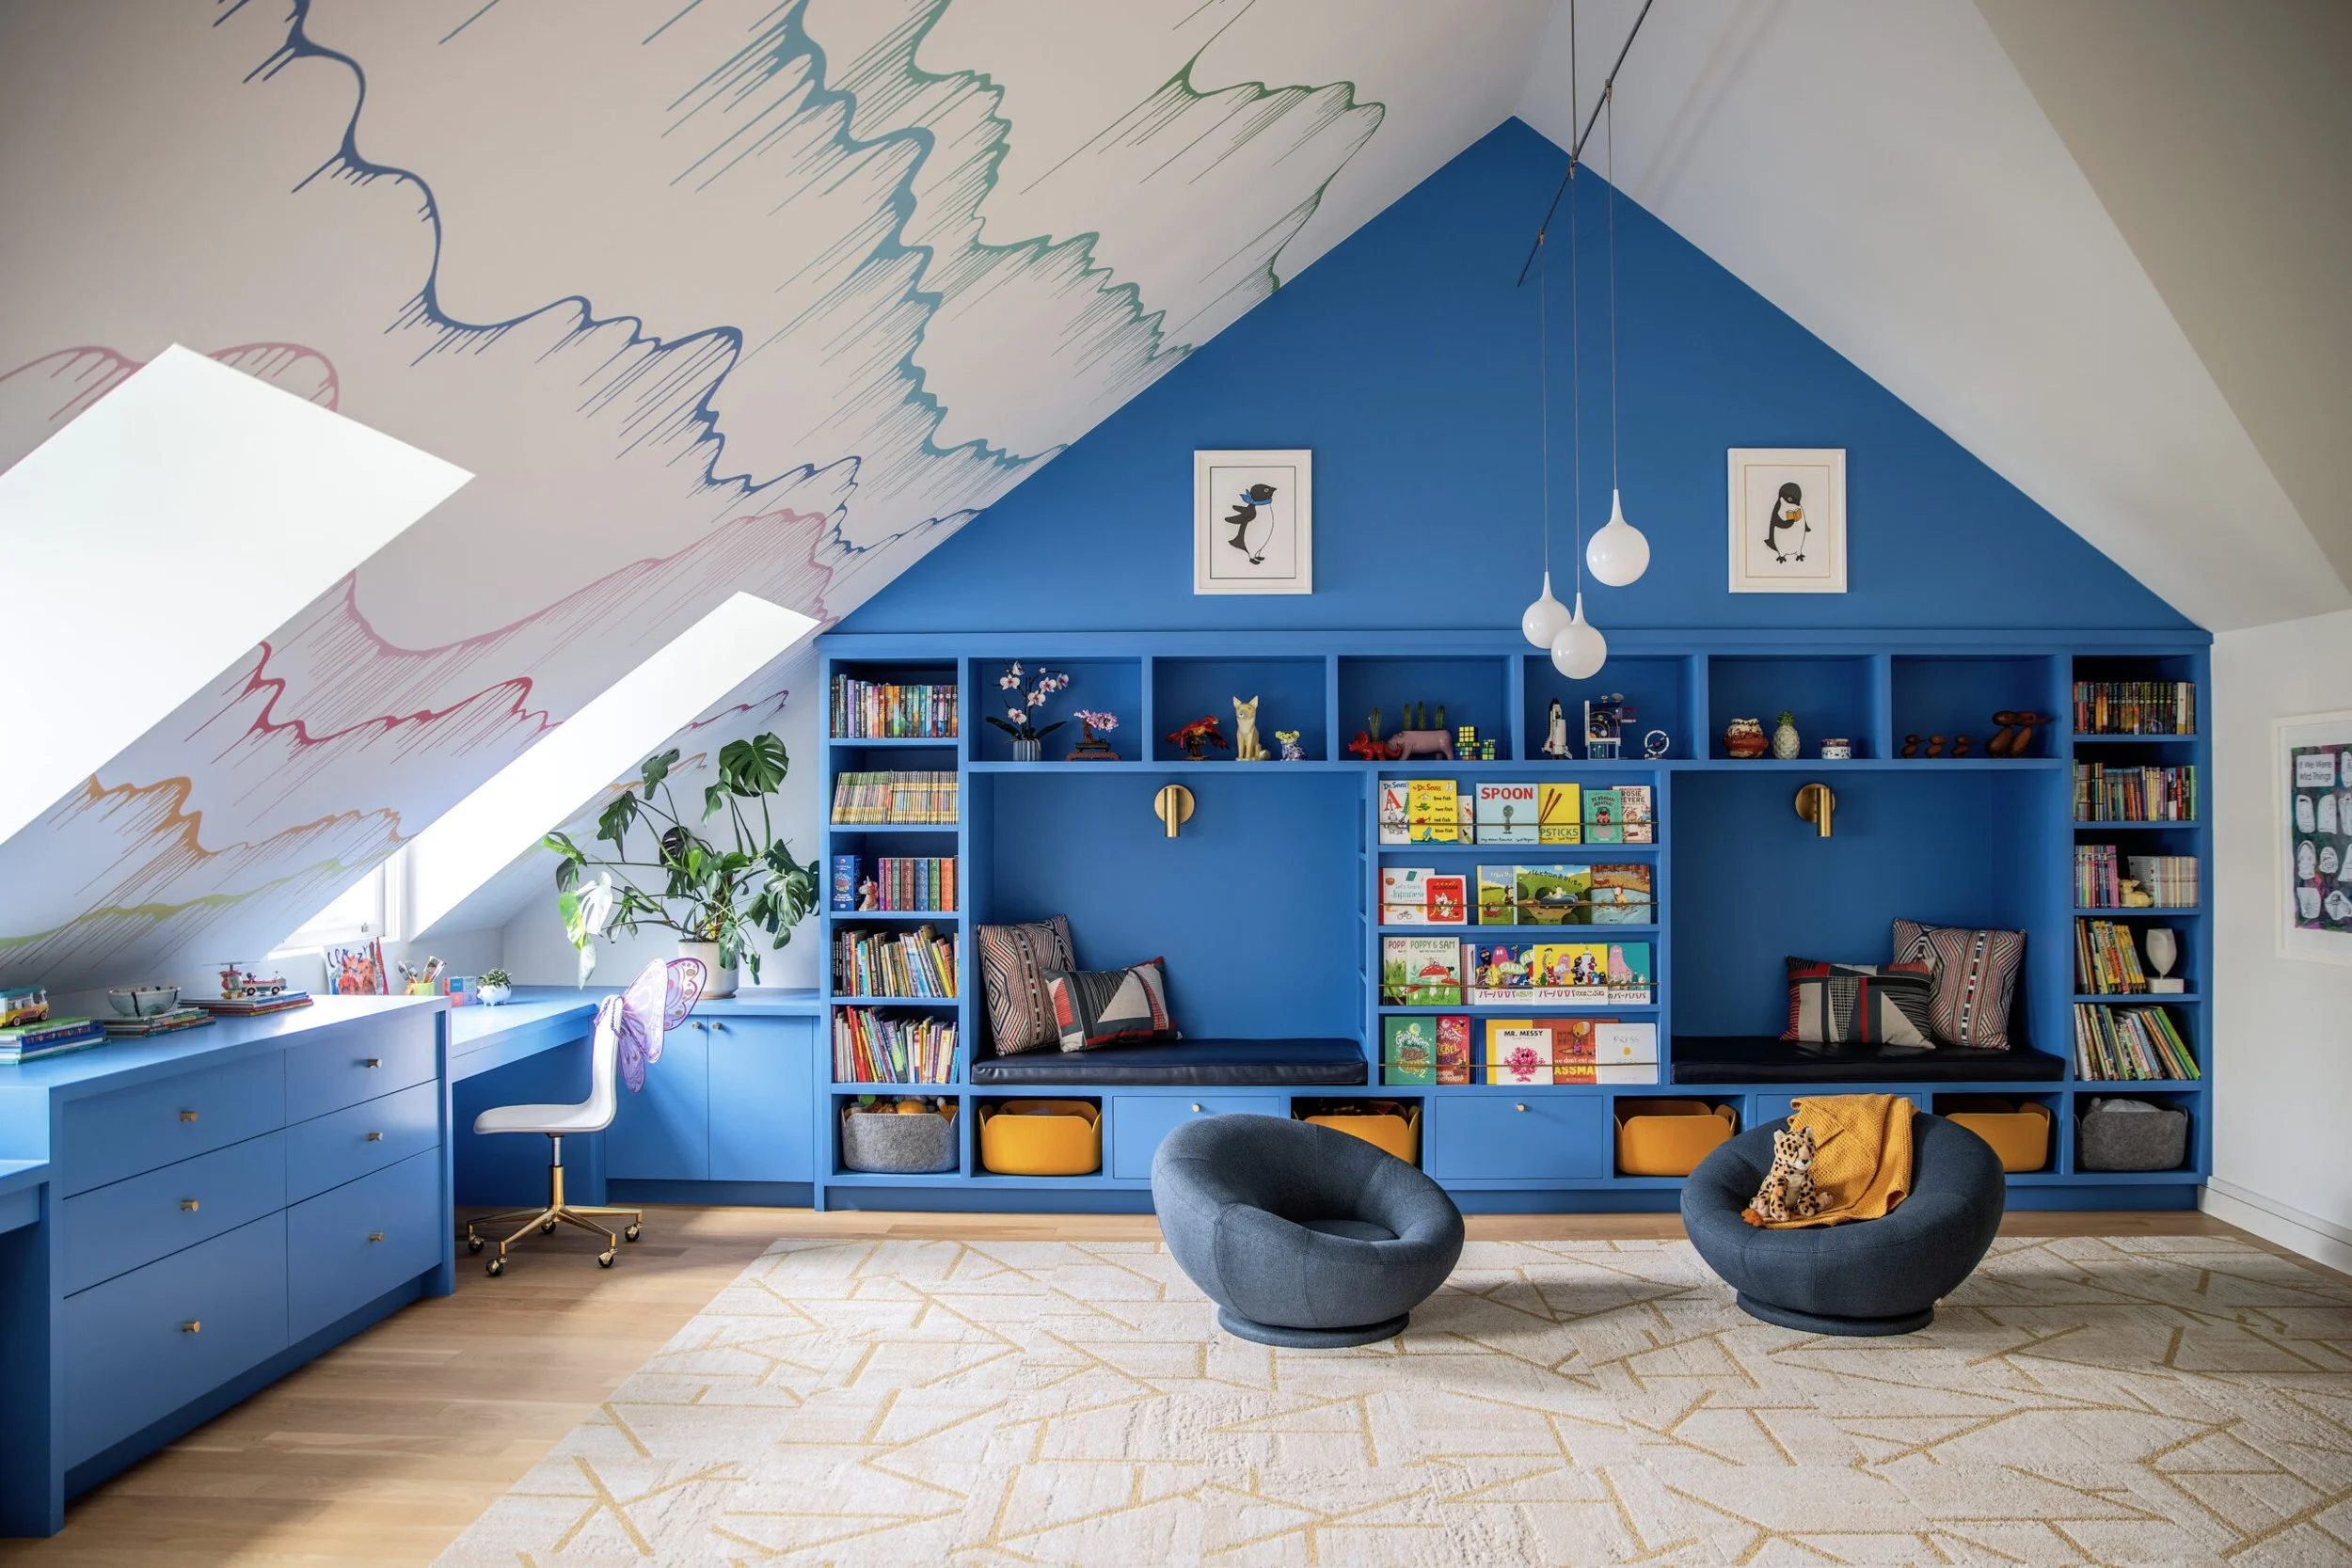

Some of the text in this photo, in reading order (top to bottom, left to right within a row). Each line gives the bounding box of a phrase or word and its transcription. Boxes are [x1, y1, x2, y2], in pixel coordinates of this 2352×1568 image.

[1481, 787, 1534, 800] SPOON
[1388, 941, 1406, 949] POPP
[1410, 941, 1431, 949] POPPY
[1438, 941, 1455, 949] SAM
[1419, 1069, 1426, 1078] 2
